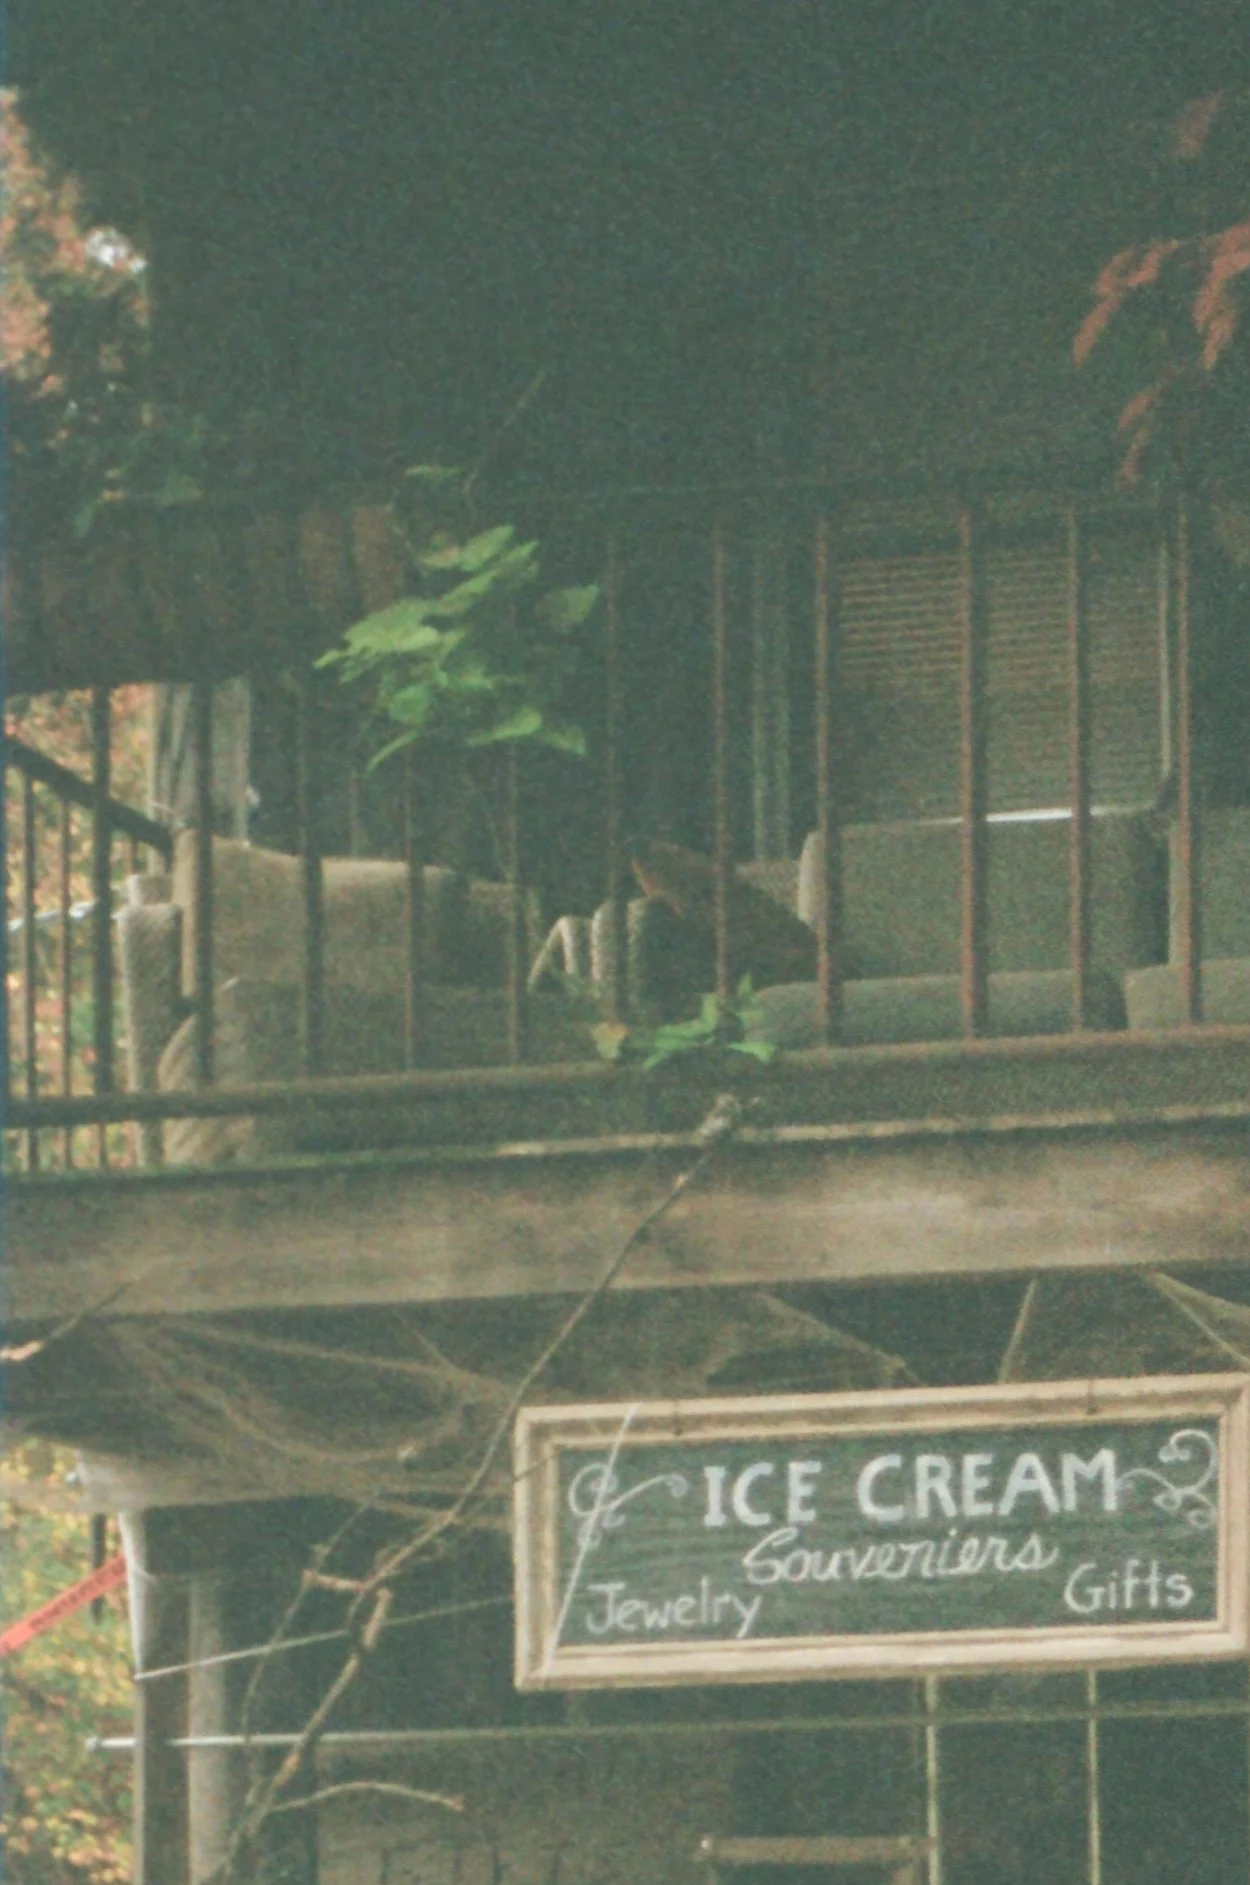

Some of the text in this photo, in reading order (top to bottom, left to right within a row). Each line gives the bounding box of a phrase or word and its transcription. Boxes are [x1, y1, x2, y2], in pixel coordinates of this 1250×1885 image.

[703, 1448, 1118, 1528] ICE CREAM
[742, 1527, 1061, 1585] Souveniers
[1063, 1558, 1194, 1614] Gifts
[584, 1575, 763, 1639] Jewelry
